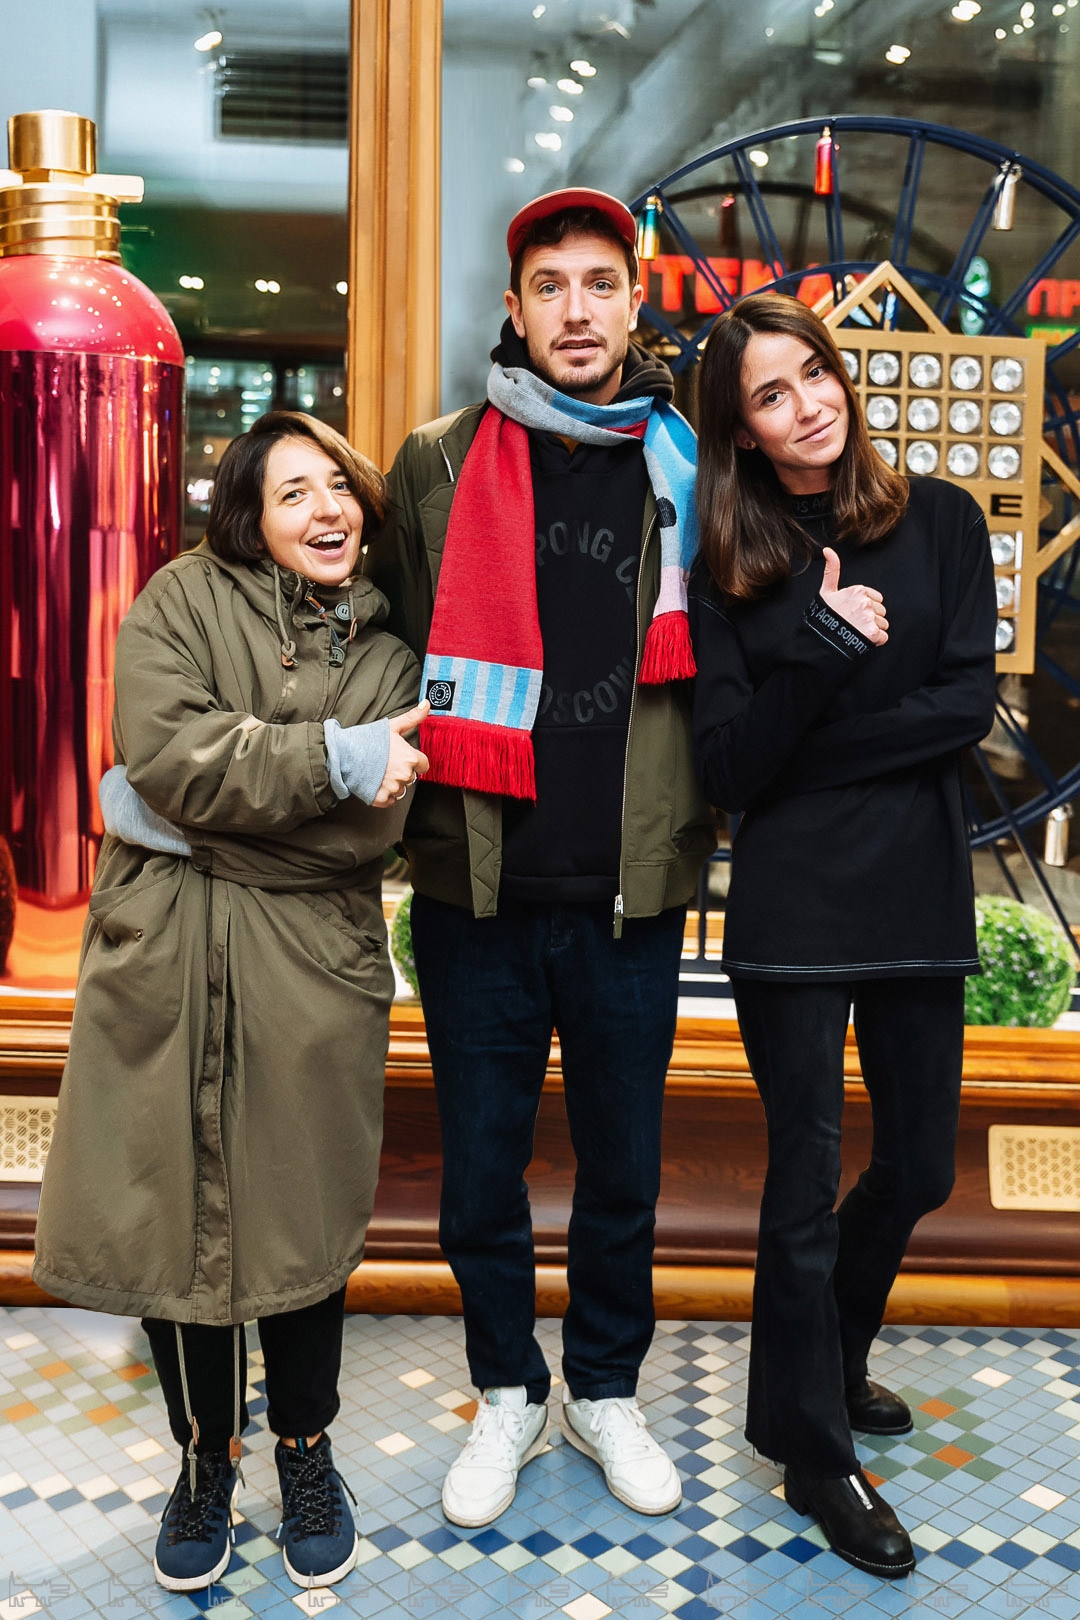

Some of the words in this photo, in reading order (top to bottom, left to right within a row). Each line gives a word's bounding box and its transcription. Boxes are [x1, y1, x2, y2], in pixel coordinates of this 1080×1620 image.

[639, 255, 835, 317] ТЕКА
[991, 494, 1023, 518] E
[815, 608, 839, 631] Acne
